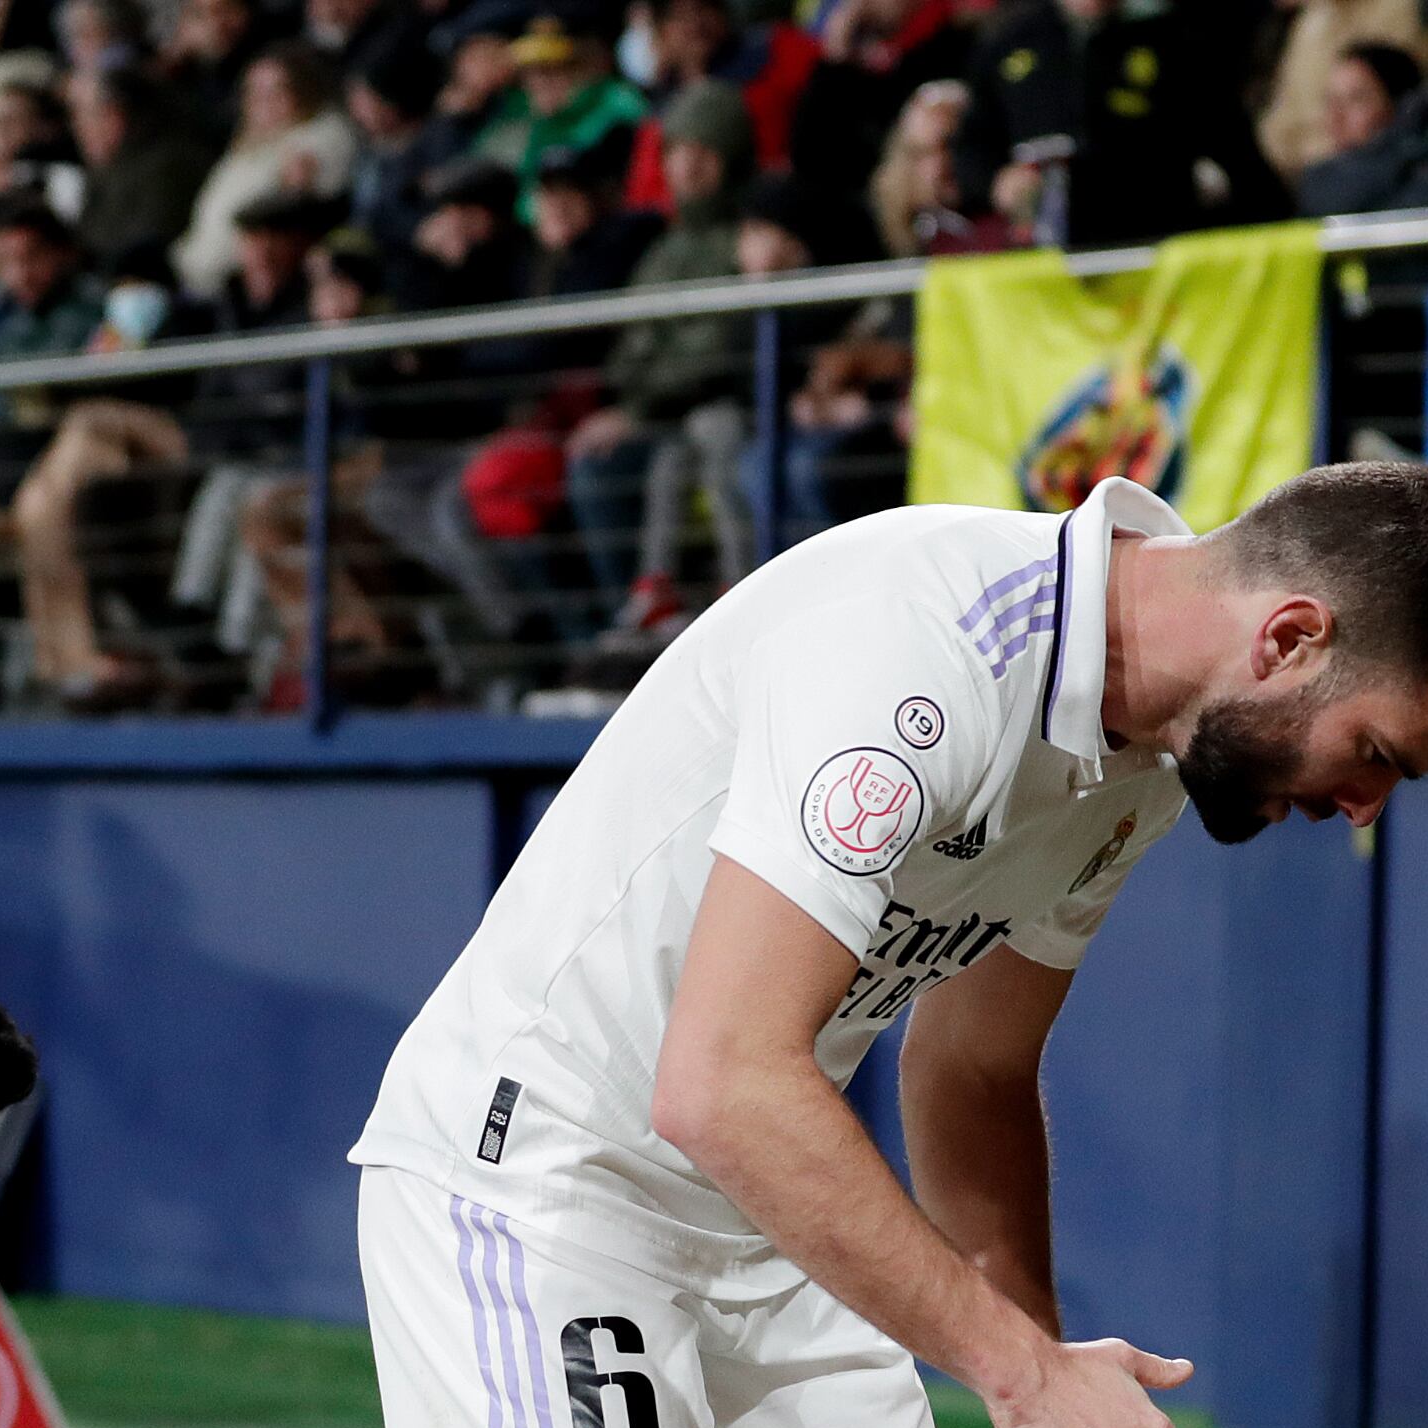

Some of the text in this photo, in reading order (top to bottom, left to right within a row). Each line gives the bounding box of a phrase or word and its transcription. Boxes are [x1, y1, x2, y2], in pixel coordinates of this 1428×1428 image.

[908, 707, 934, 737] 19
[811, 783, 826, 823] COPA
[813, 828, 830, 846] DE
[864, 857, 881, 867] EL
